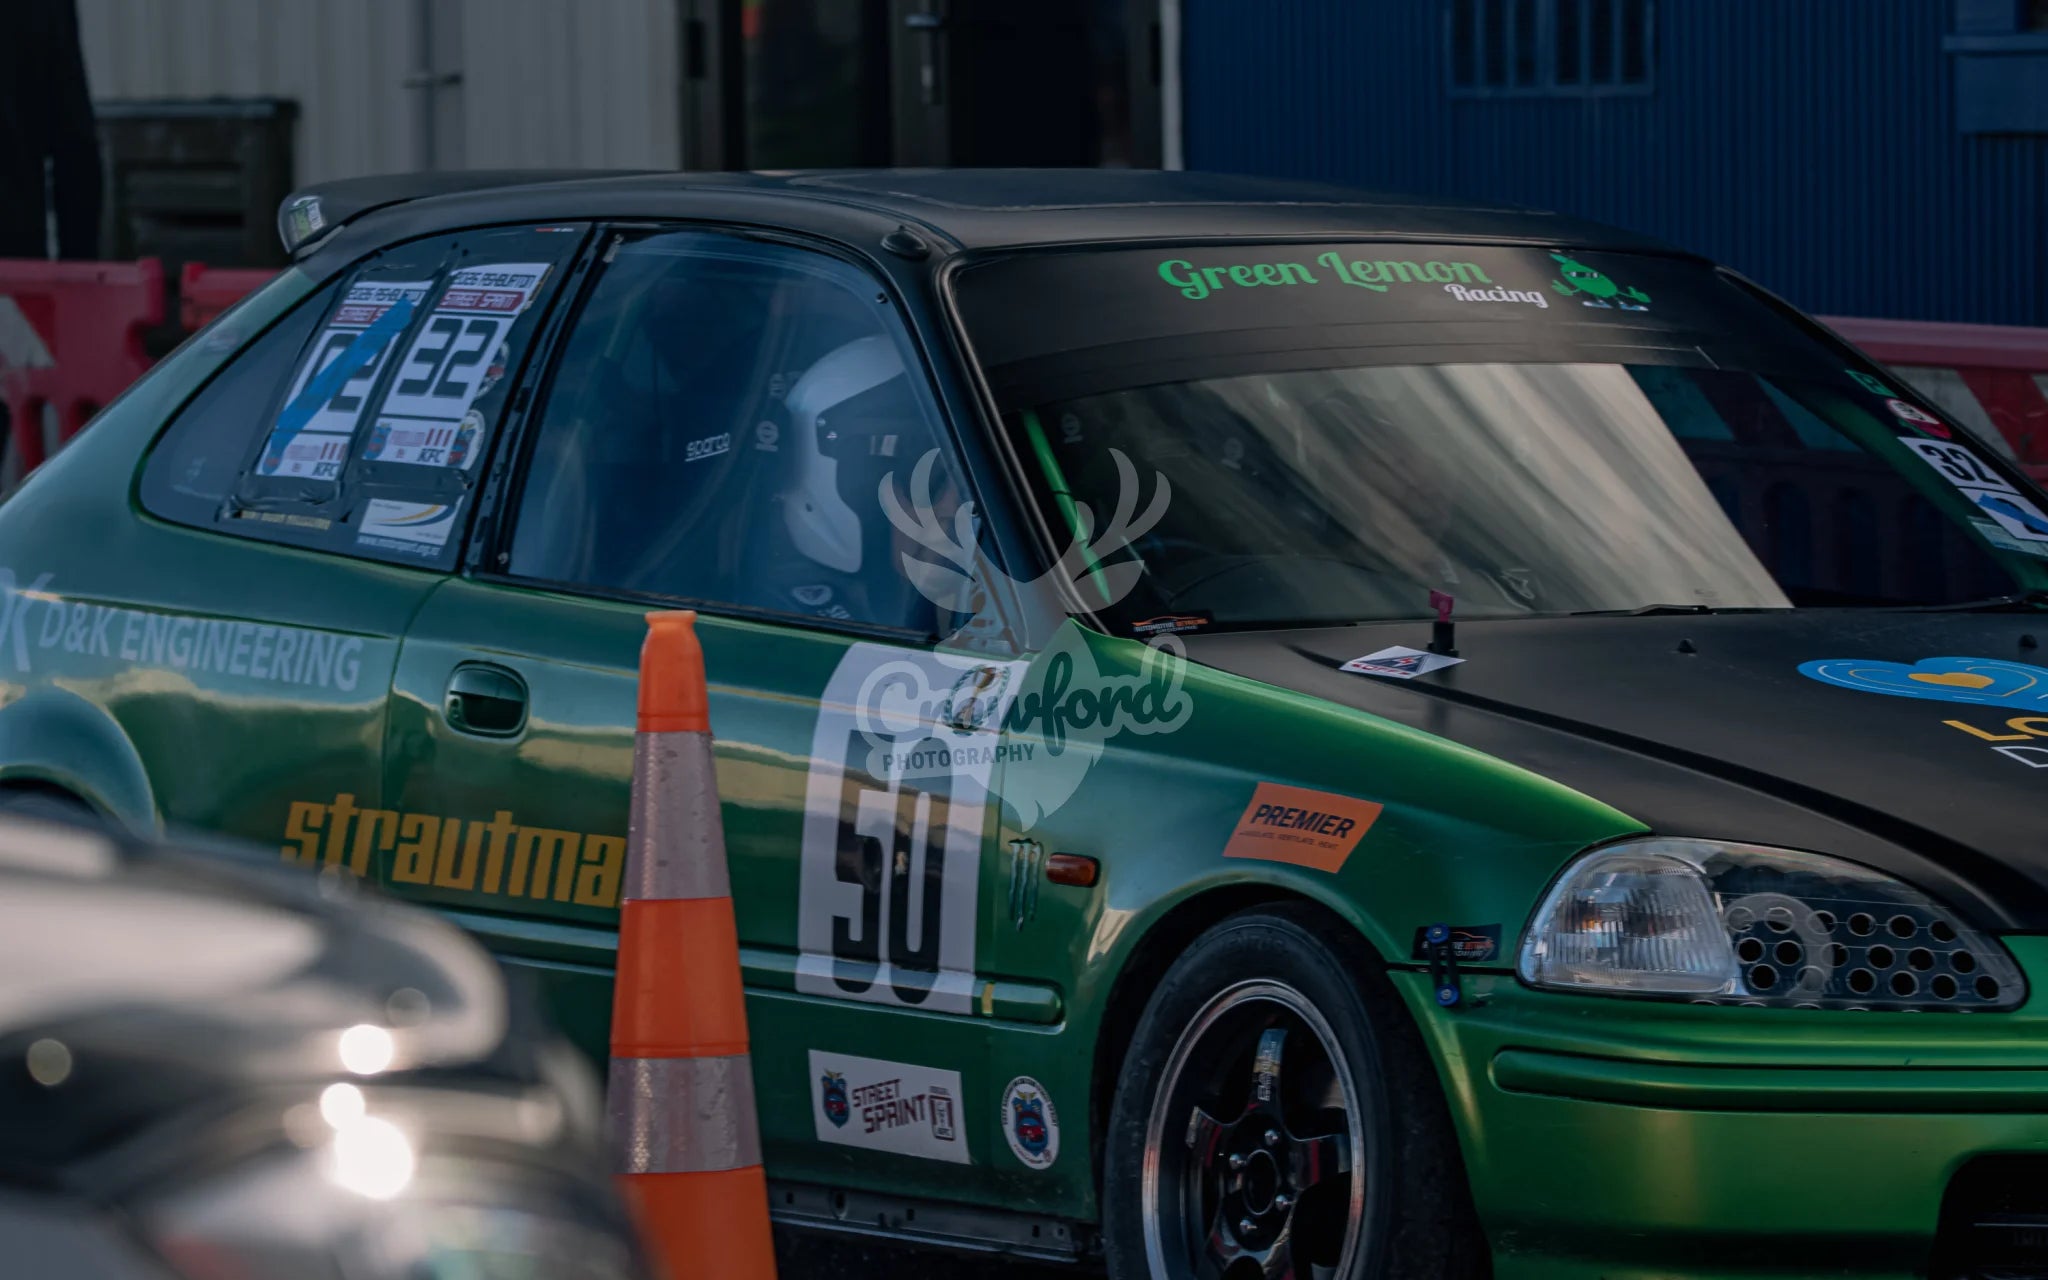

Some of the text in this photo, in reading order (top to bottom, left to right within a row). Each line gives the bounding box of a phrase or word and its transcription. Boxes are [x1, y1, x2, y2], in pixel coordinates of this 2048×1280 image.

[1158, 252, 1492, 300] Green Lemon
[1443, 283, 1550, 309] Racing
[397, 318, 499, 399] 32
[311, 462, 338, 477] KFC
[416, 448, 444, 464] KFC
[38, 601, 365, 692] D&K ENGINEERING
[1250, 804, 1356, 840] PREMIER
[280, 793, 627, 909] strautma
[832, 729, 954, 1005] 50
[852, 1078, 902, 1108] STREET
[862, 1094, 926, 1134] SPRINT
